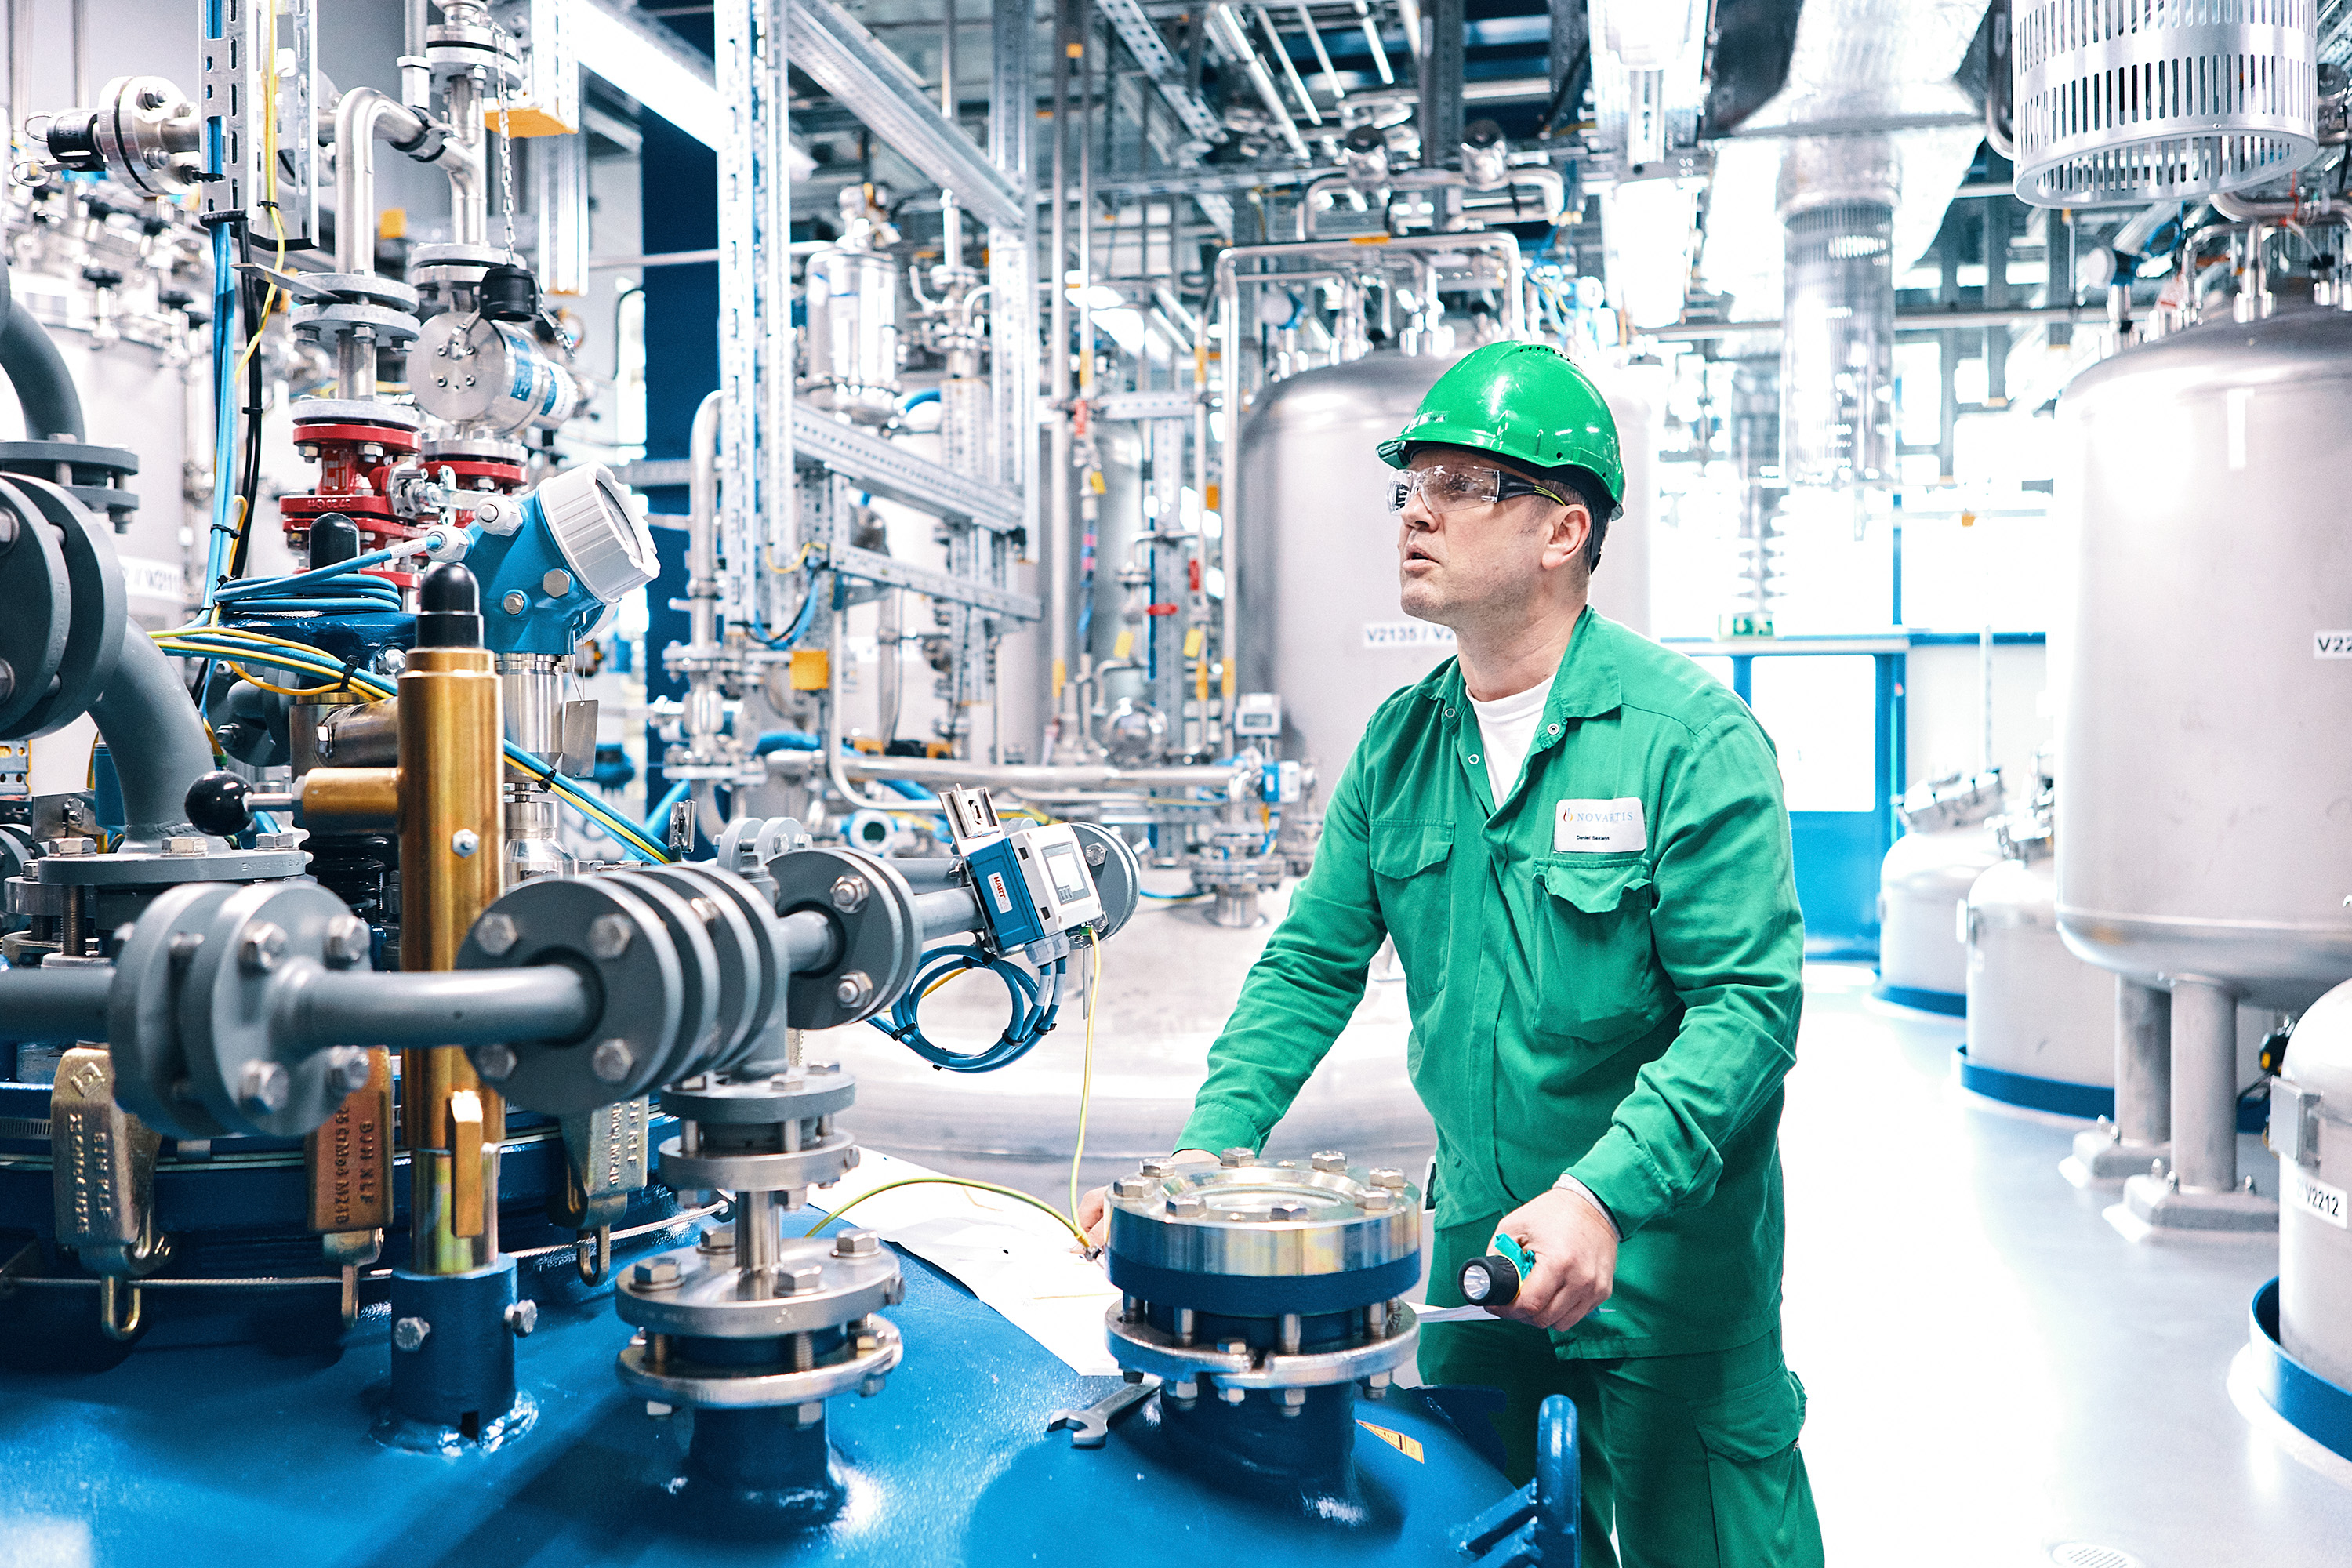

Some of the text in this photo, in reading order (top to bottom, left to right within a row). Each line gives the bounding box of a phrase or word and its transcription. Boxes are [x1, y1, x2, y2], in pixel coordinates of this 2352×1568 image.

[1577, 811, 1633, 822] NOVARTIS
[993, 876, 1006, 898] HART
[2305, 1181, 2339, 1218] V2212
